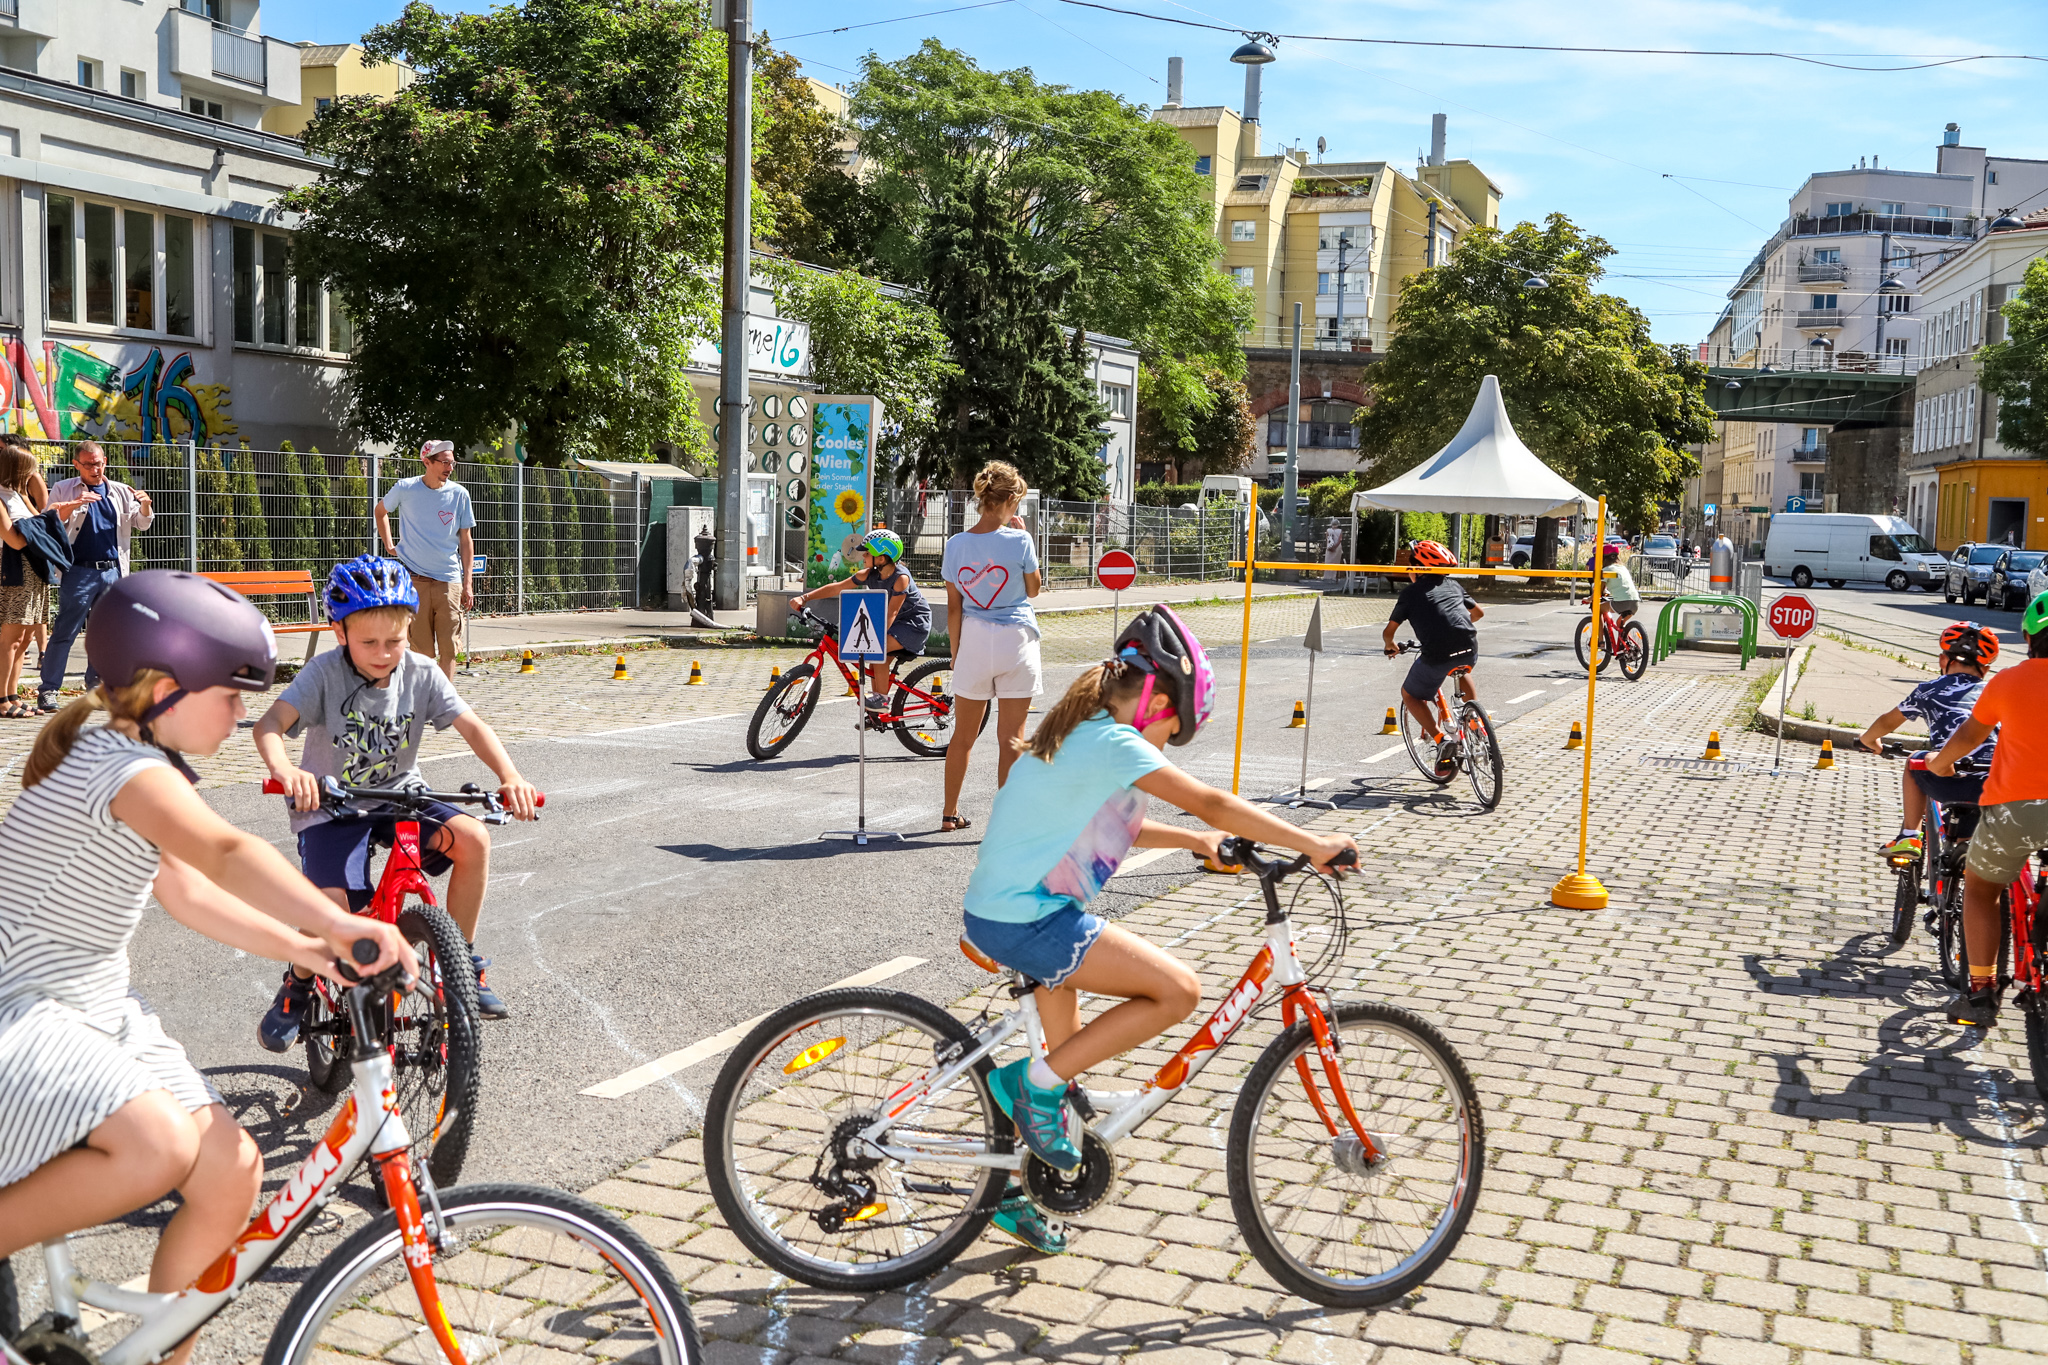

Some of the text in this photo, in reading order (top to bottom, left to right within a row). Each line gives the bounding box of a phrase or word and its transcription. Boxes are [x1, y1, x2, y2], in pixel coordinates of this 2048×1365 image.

[815, 434, 864, 450] Cooles
[814, 454, 852, 469] Wien
[832, 473, 860, 481] Sommer
[1772, 606, 1812, 627] STOP
[399, 833, 418, 841] Wien
[1209, 979, 1261, 1045] KTM
[268, 1141, 340, 1234] KTM
